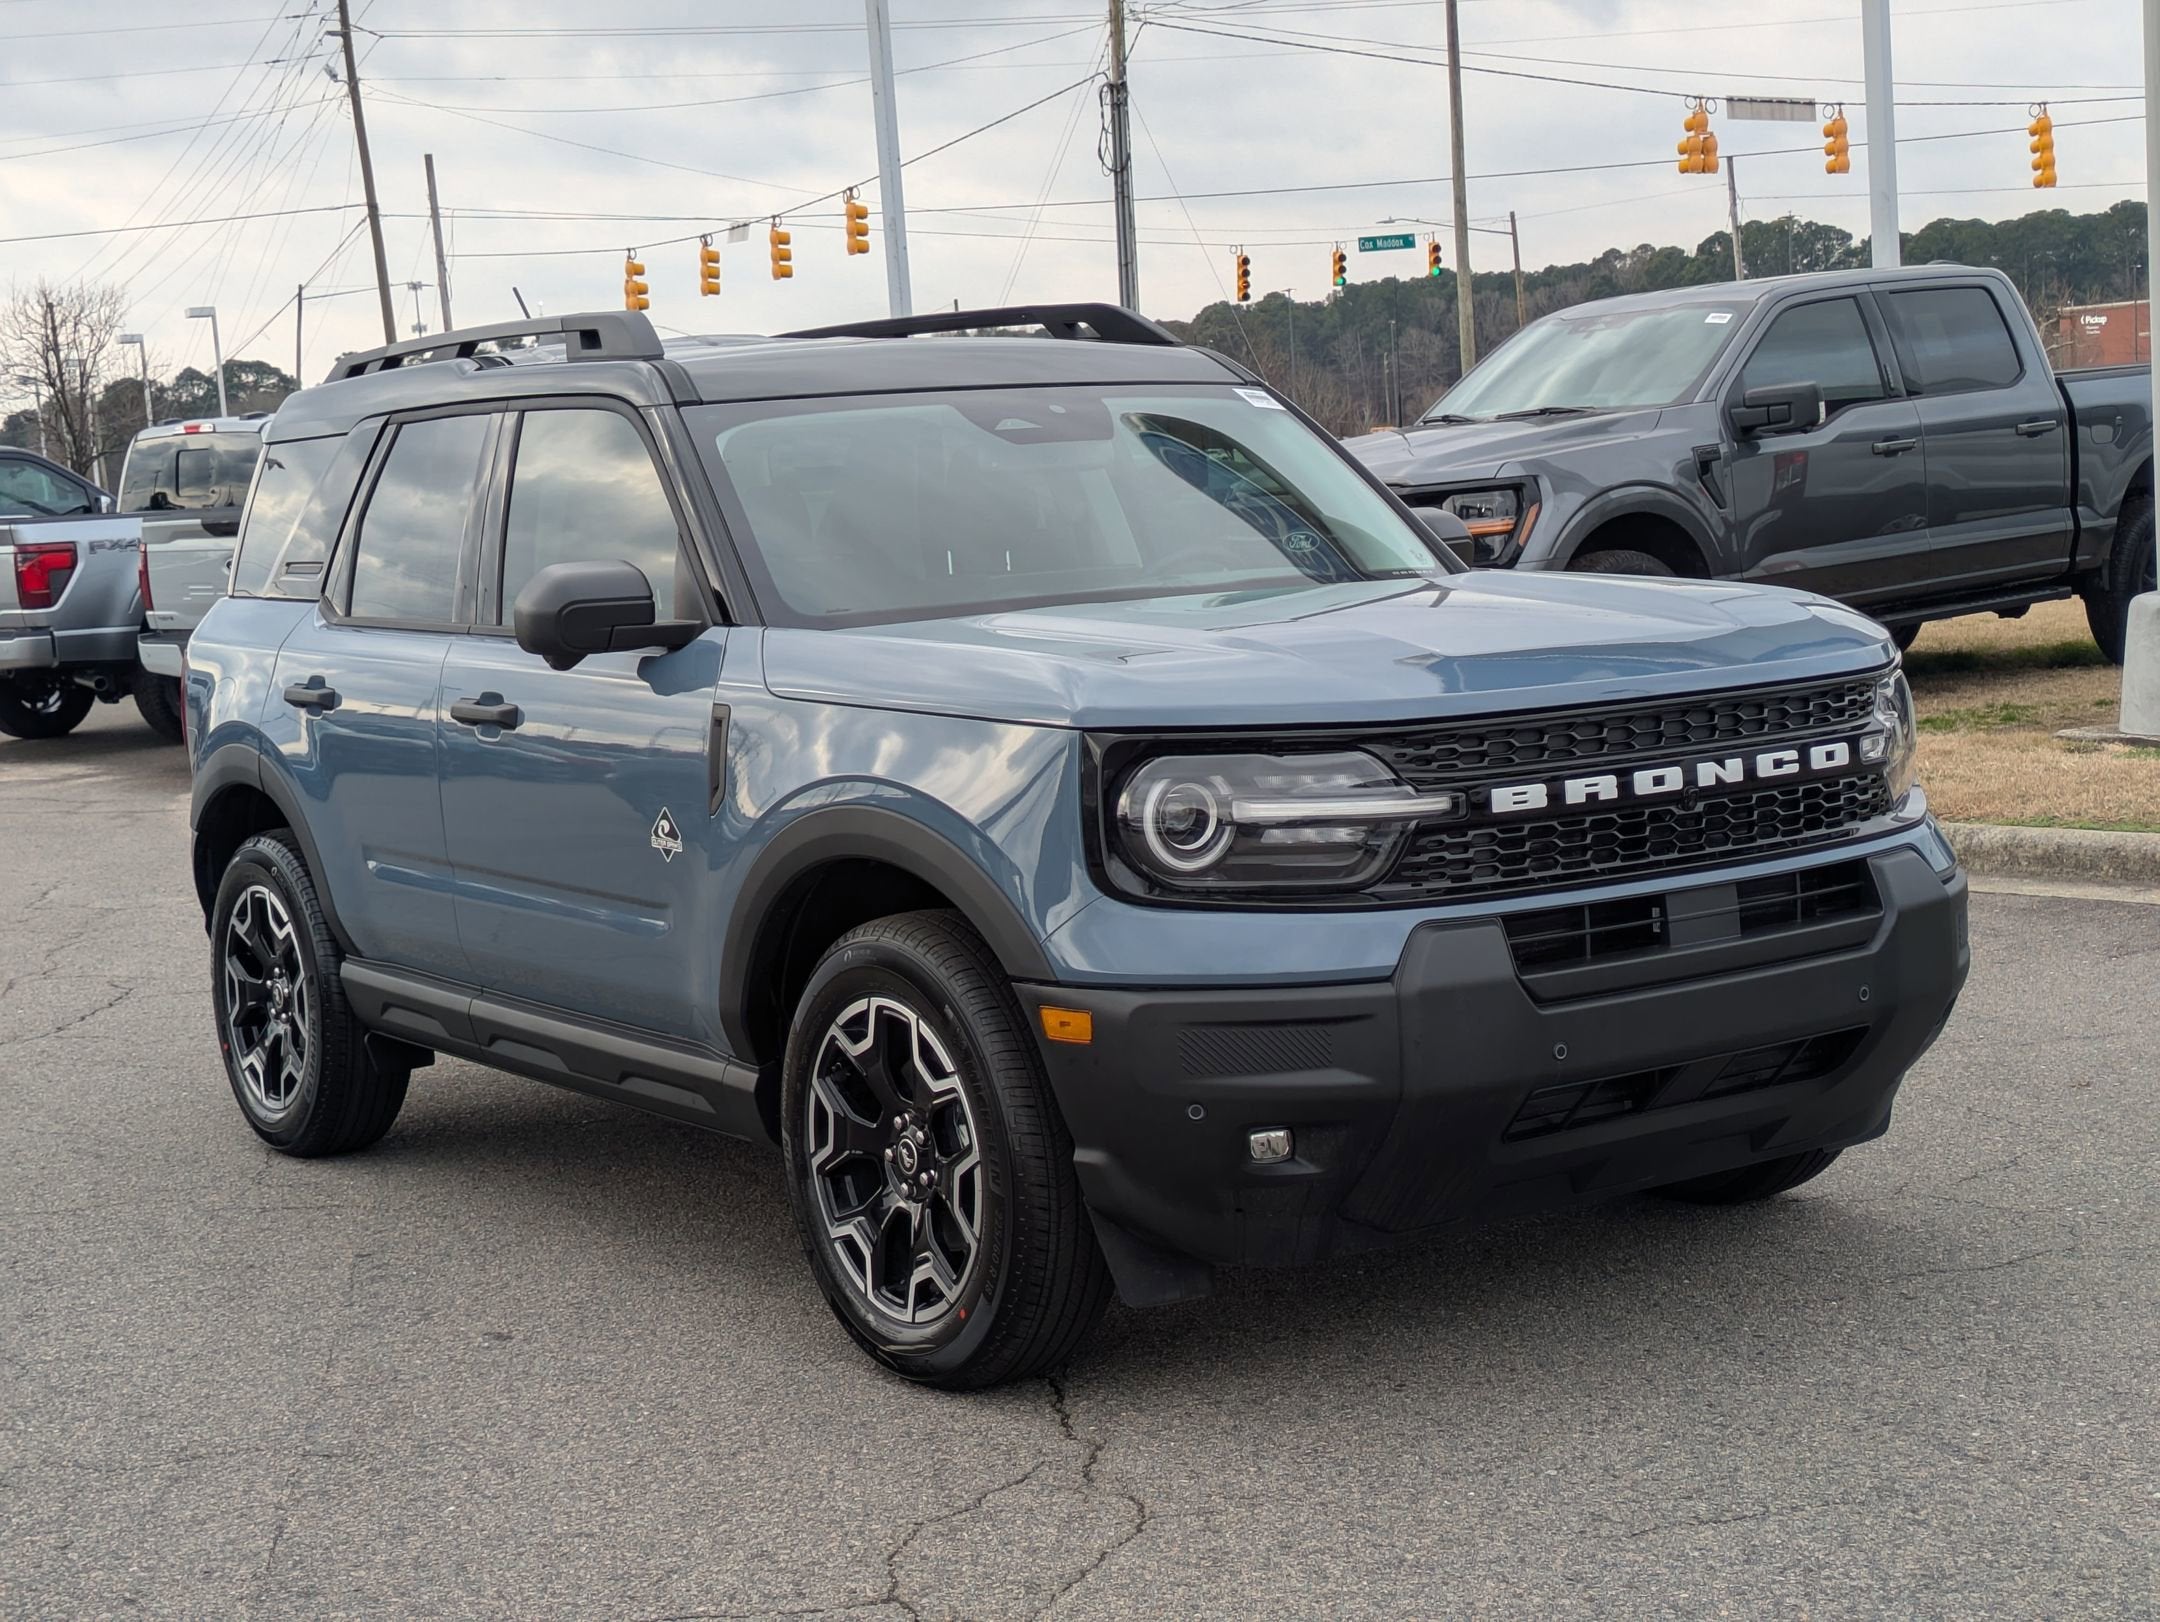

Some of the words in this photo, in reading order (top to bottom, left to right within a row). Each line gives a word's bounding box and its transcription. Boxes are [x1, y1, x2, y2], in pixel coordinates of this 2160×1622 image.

[1360, 240, 1374, 250] Cox
[1376, 238, 1404, 249] Maddox
[88, 538, 141, 554] FX4
[1289, 534, 1313, 549] Ford
[1491, 742, 1850, 813] BRONCO
